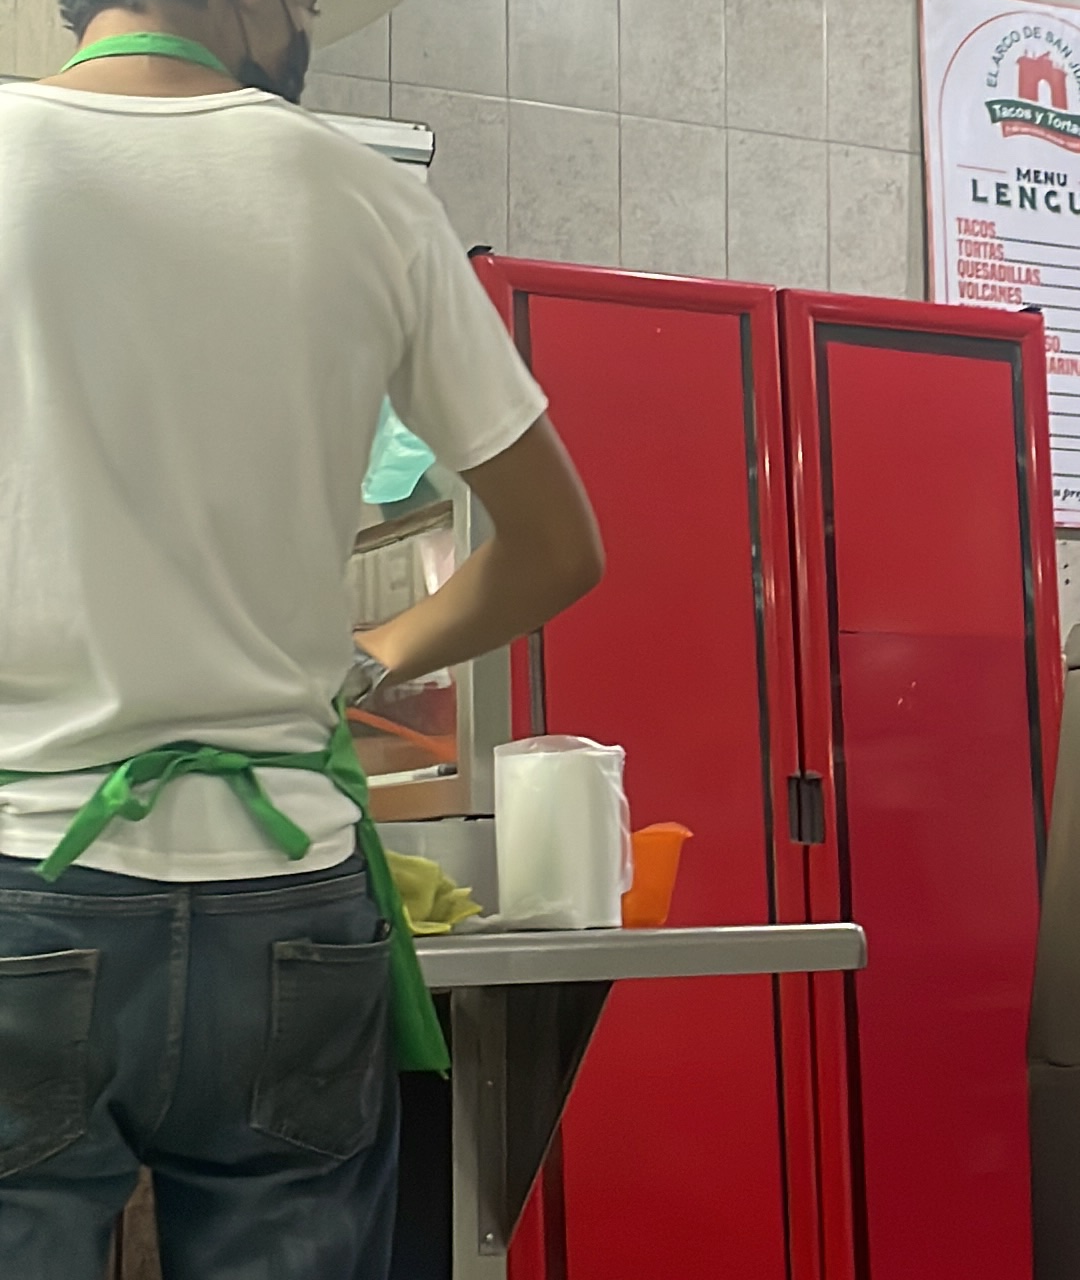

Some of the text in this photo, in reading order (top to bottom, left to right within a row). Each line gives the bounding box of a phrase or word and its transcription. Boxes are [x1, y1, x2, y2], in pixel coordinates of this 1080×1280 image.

[986, 69, 999, 88] EL
[1023, 26, 1041, 39] DE
[1045, 31, 1073, 58] SAN
[992, 104, 1032, 119] Tacos
[1035, 111, 1044, 125] y
[1016, 167, 1067, 187] MENU
[956, 217, 996, 239] TACOS
[957, 238, 1004, 261] TORTAS
[957, 259, 1041, 286] QUESADILLAS
[958, 281, 1022, 305] VOLCANES
